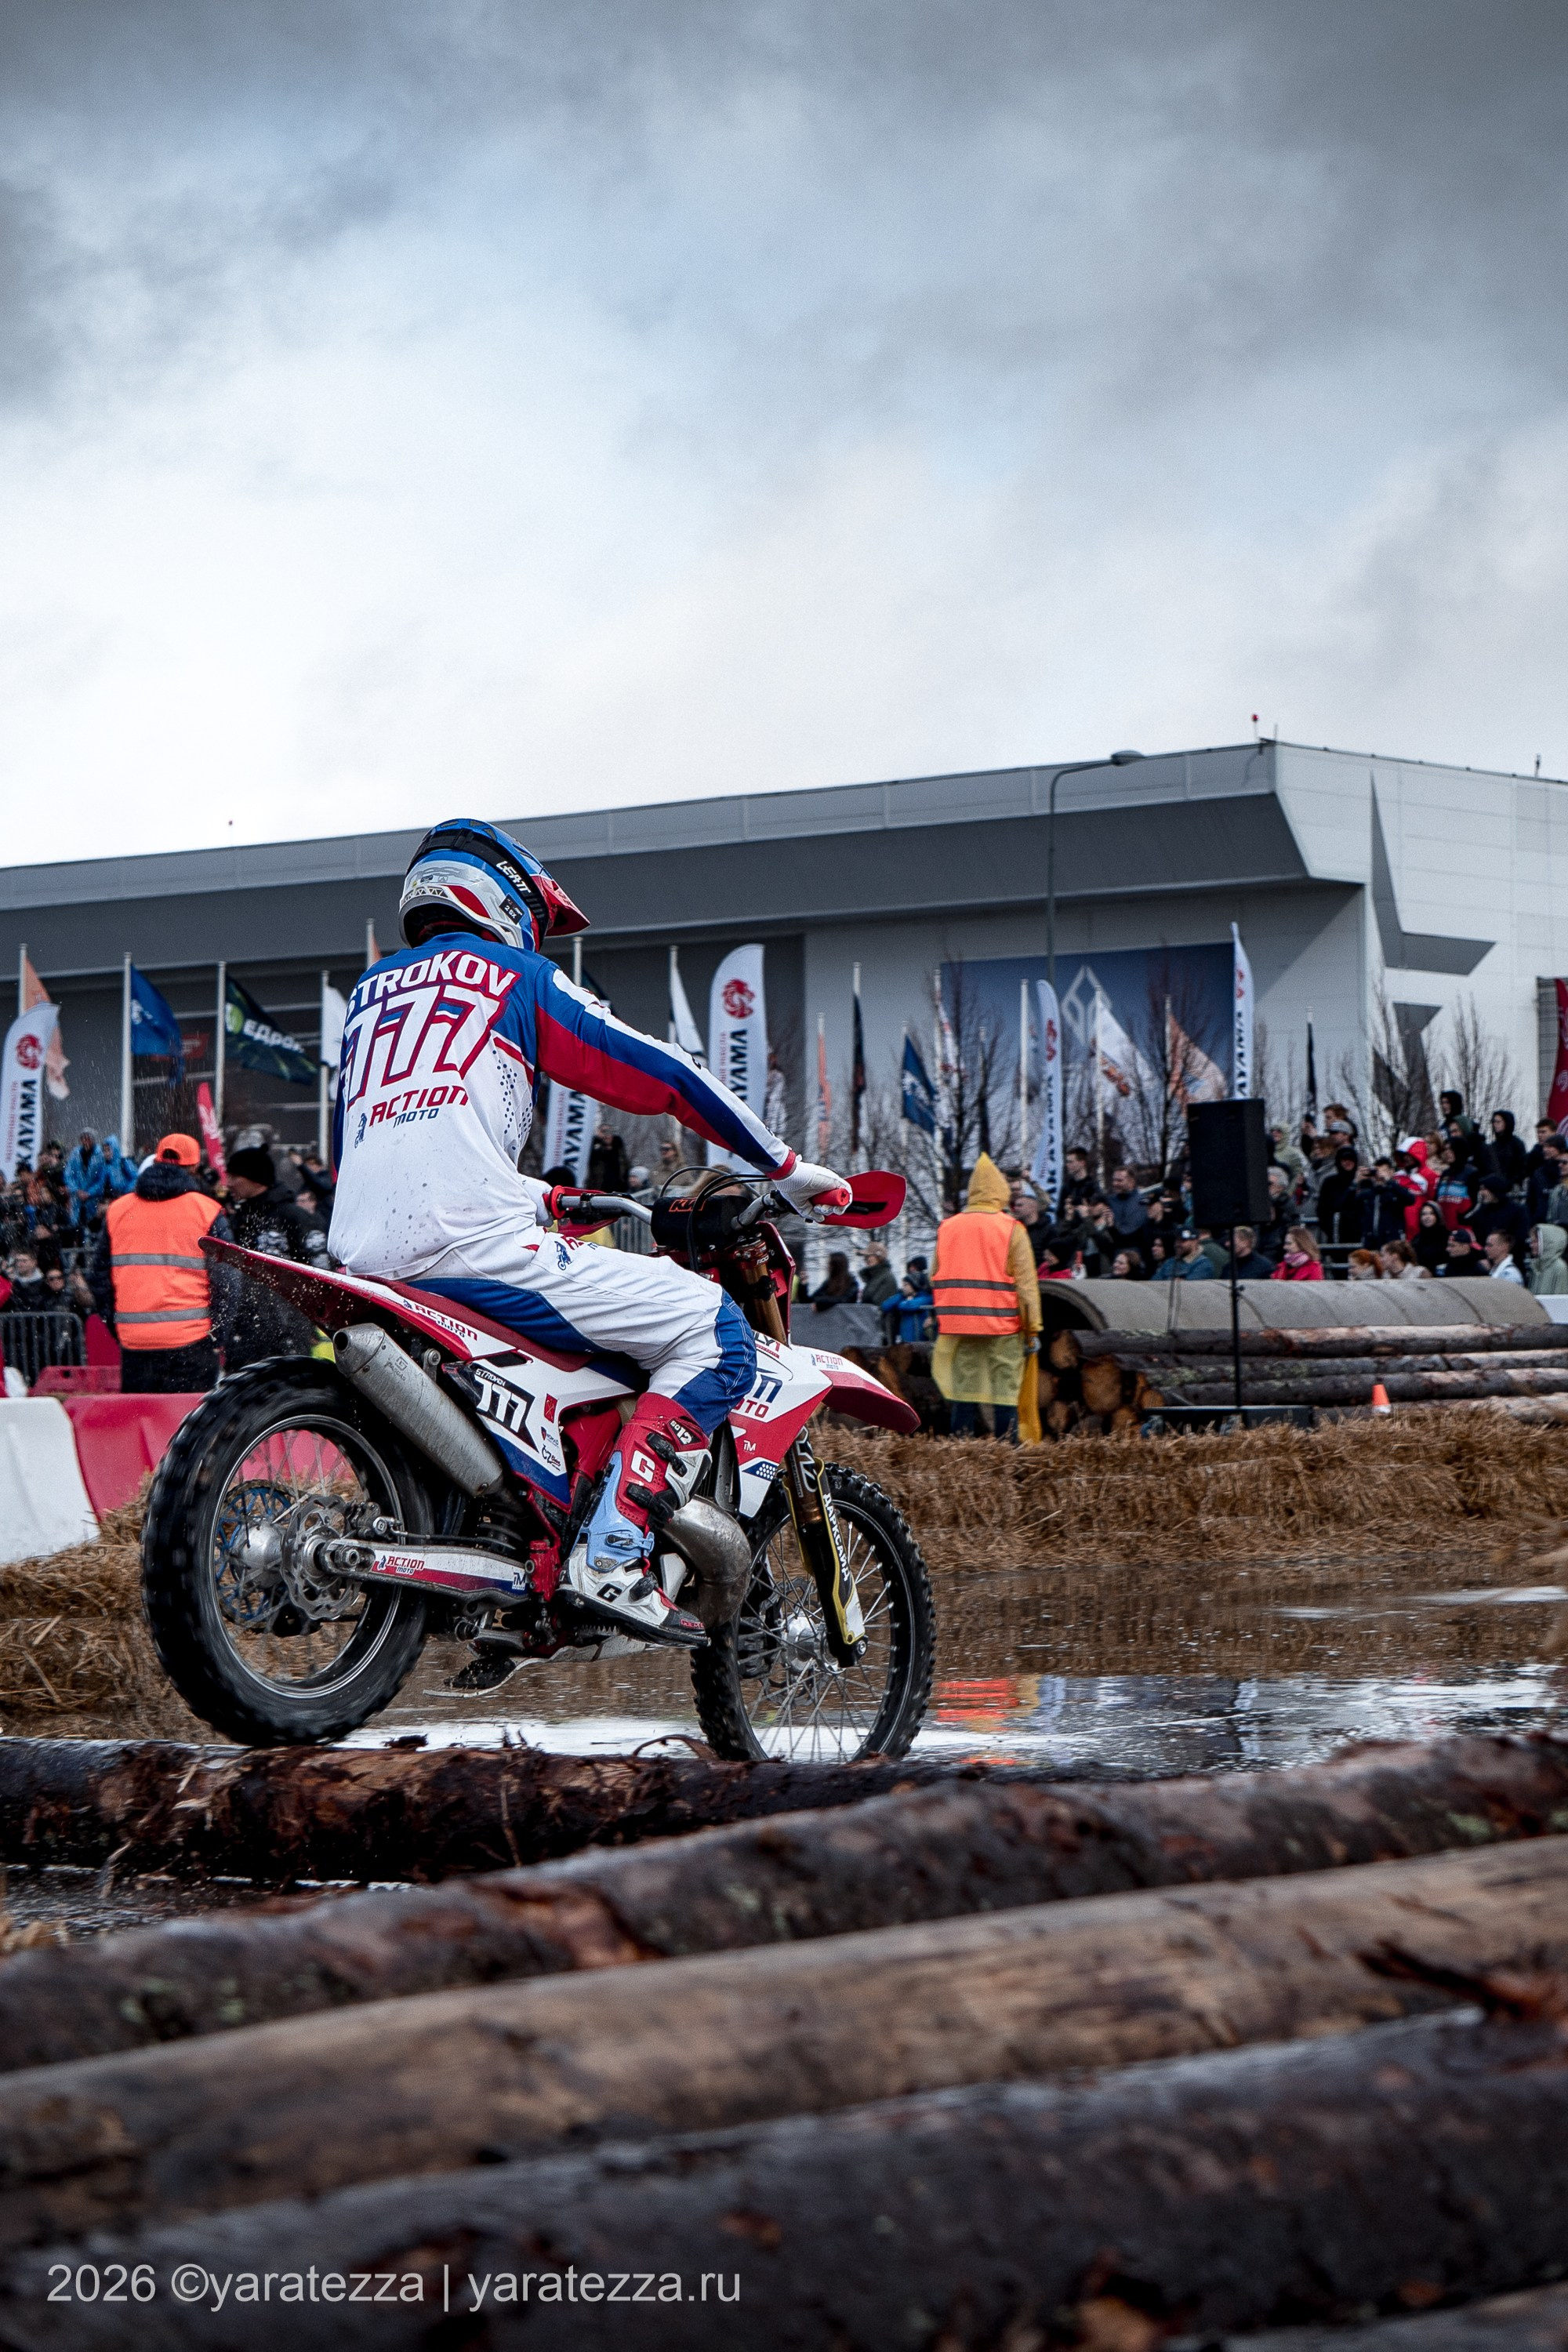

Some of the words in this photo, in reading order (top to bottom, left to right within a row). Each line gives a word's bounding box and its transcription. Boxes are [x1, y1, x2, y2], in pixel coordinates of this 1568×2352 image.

[495, 861, 532, 893] LEATT
[369, 1085, 469, 1127] ACTION
[394, 1107, 439, 1129] MOTO
[415, 1303, 478, 1341] ACTION
[815, 1354, 844, 1367] ACTION
[474, 1374, 528, 1433] 777
[630, 1450, 655, 1483] G
[823, 1492, 851, 1583] ДАРКСАЙД
[387, 1555, 424, 1570] ACTION
[597, 1583, 622, 1602] G
